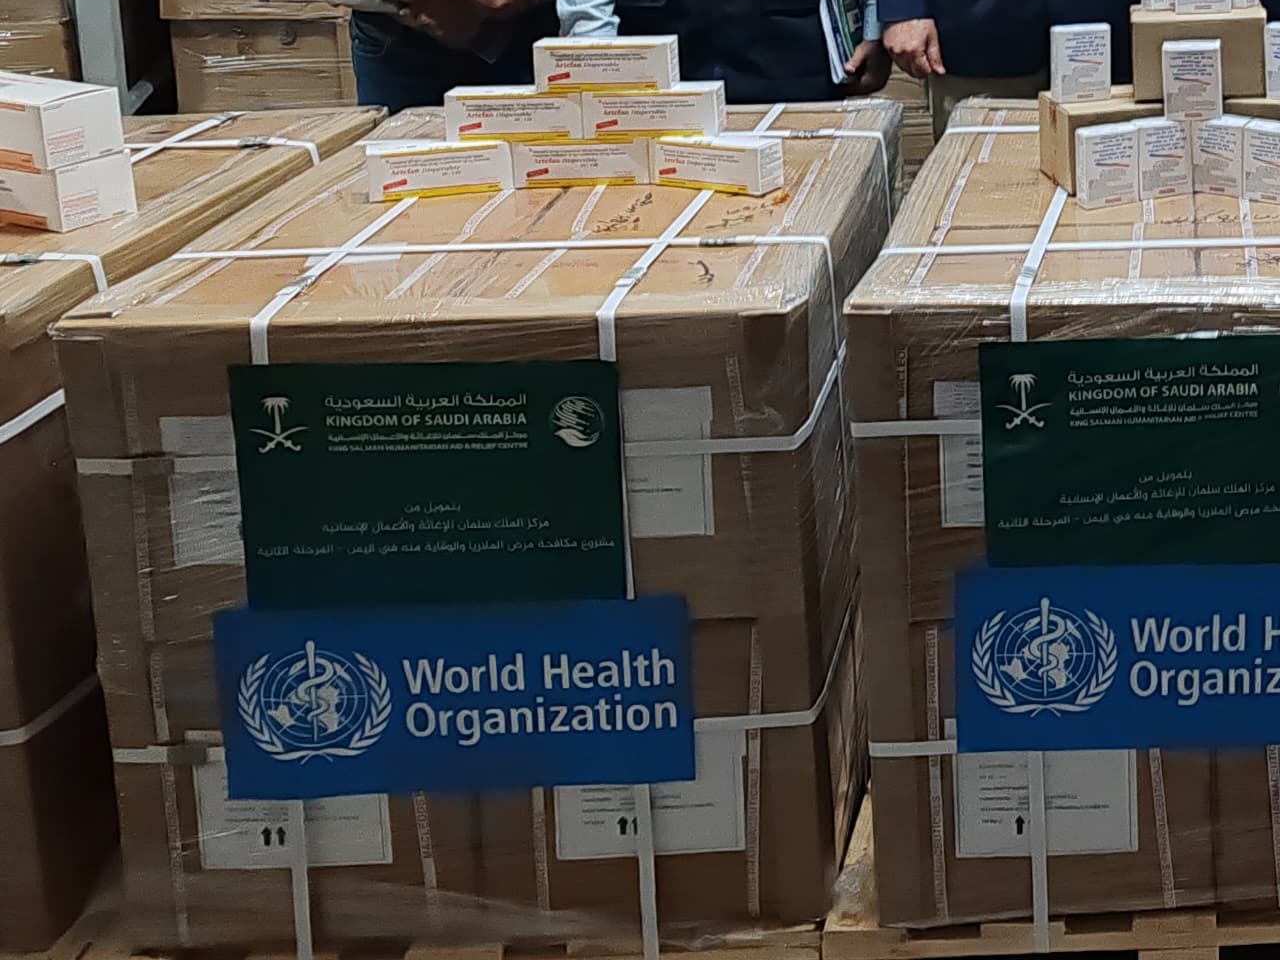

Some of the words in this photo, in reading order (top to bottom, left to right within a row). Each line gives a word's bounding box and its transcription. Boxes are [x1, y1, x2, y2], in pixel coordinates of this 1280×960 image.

[1068, 369, 1140, 387] السعودية
[1145, 366, 1195, 382] العربية
[1200, 364, 1258, 378] المملكة
[464, 393, 527, 407] المملكة
[1069, 387, 1137, 402] KINGDOM
[1140, 386, 1159, 398] OF
[1162, 384, 1204, 397] SAUDI
[1207, 382, 1259, 396] ARABIA
[325, 395, 401, 412] السعودية
[406, 394, 459, 411] العربية
[326, 414, 398, 427] KINGDOM
[401, 414, 421, 426] OF
[425, 413, 470, 426] SAUDI
[473, 412, 527, 425] ARABIA
[1130, 613, 1246, 653] World
[403, 653, 526, 695] World
[544, 648, 676, 690] Health
[405, 695, 678, 746] Organization
